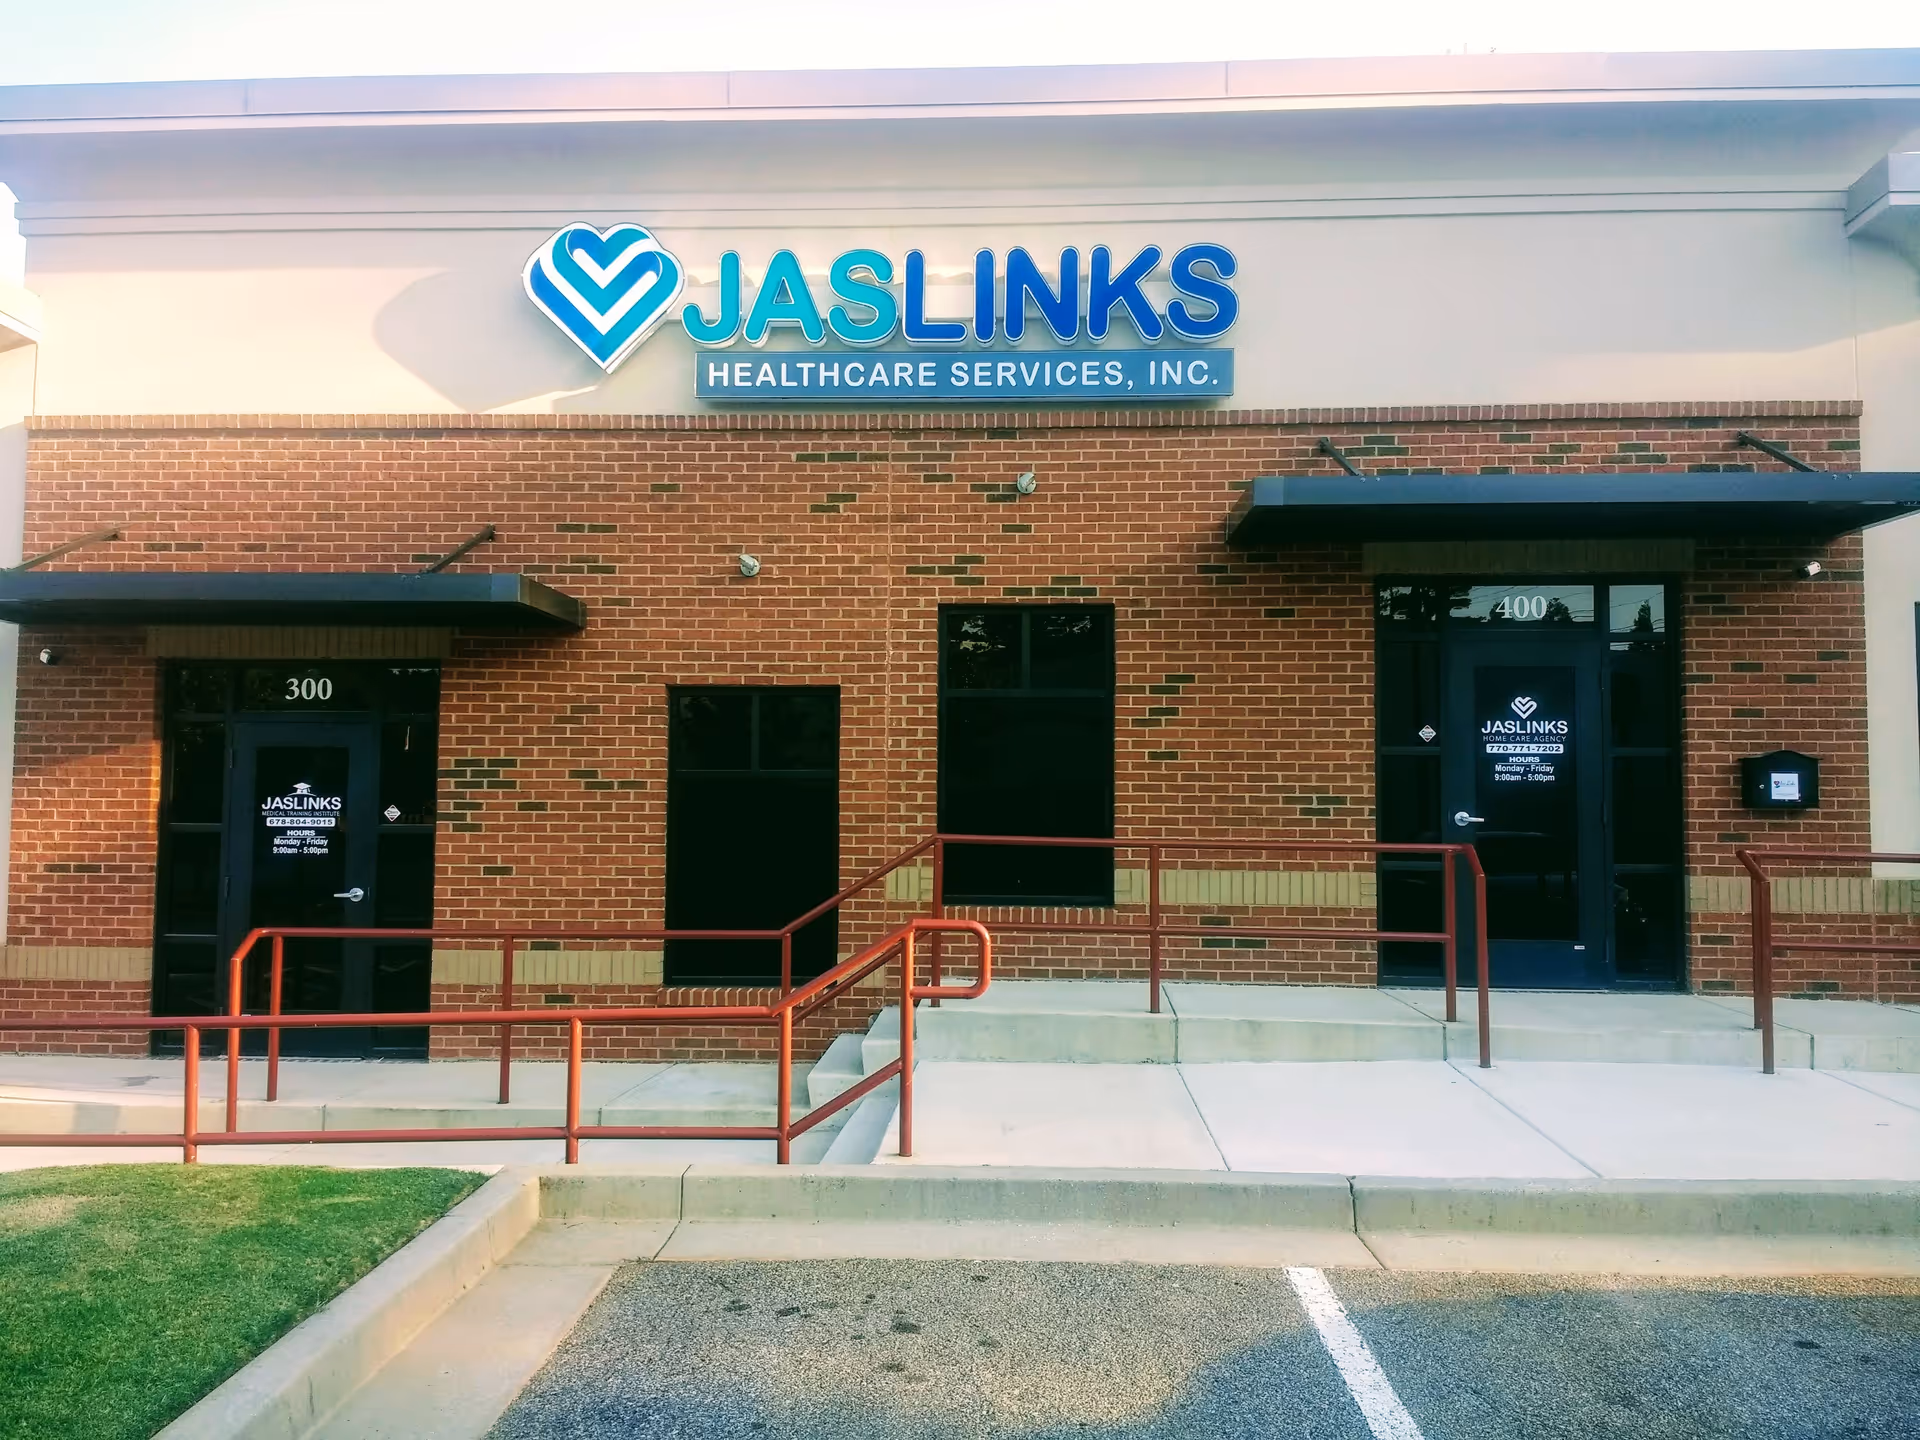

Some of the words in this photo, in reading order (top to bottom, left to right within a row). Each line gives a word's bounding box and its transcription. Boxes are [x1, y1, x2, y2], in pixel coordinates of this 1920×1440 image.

[682, 243, 1239, 347] JASLINKS
[708, 362, 937, 387] HEALTHCARE
[950, 361, 1134, 390] SERVICES,
[1150, 360, 1218, 385] INC.
[1495, 596, 1548, 619] 400
[285, 678, 333, 700] 300
[1481, 720, 1568, 734] JASLINKS
[1495, 765, 1525, 774] Monday
[1530, 765, 1555, 774] Friday
[1527, 774, 1555, 783] 5:00pm
[261, 796, 342, 810] JASLINKS
[273, 838, 301, 847] Monday
[306, 838, 329, 847] Friday
[272, 846, 298, 854] 9:00am
[303, 846, 329, 855] 5:00pm
